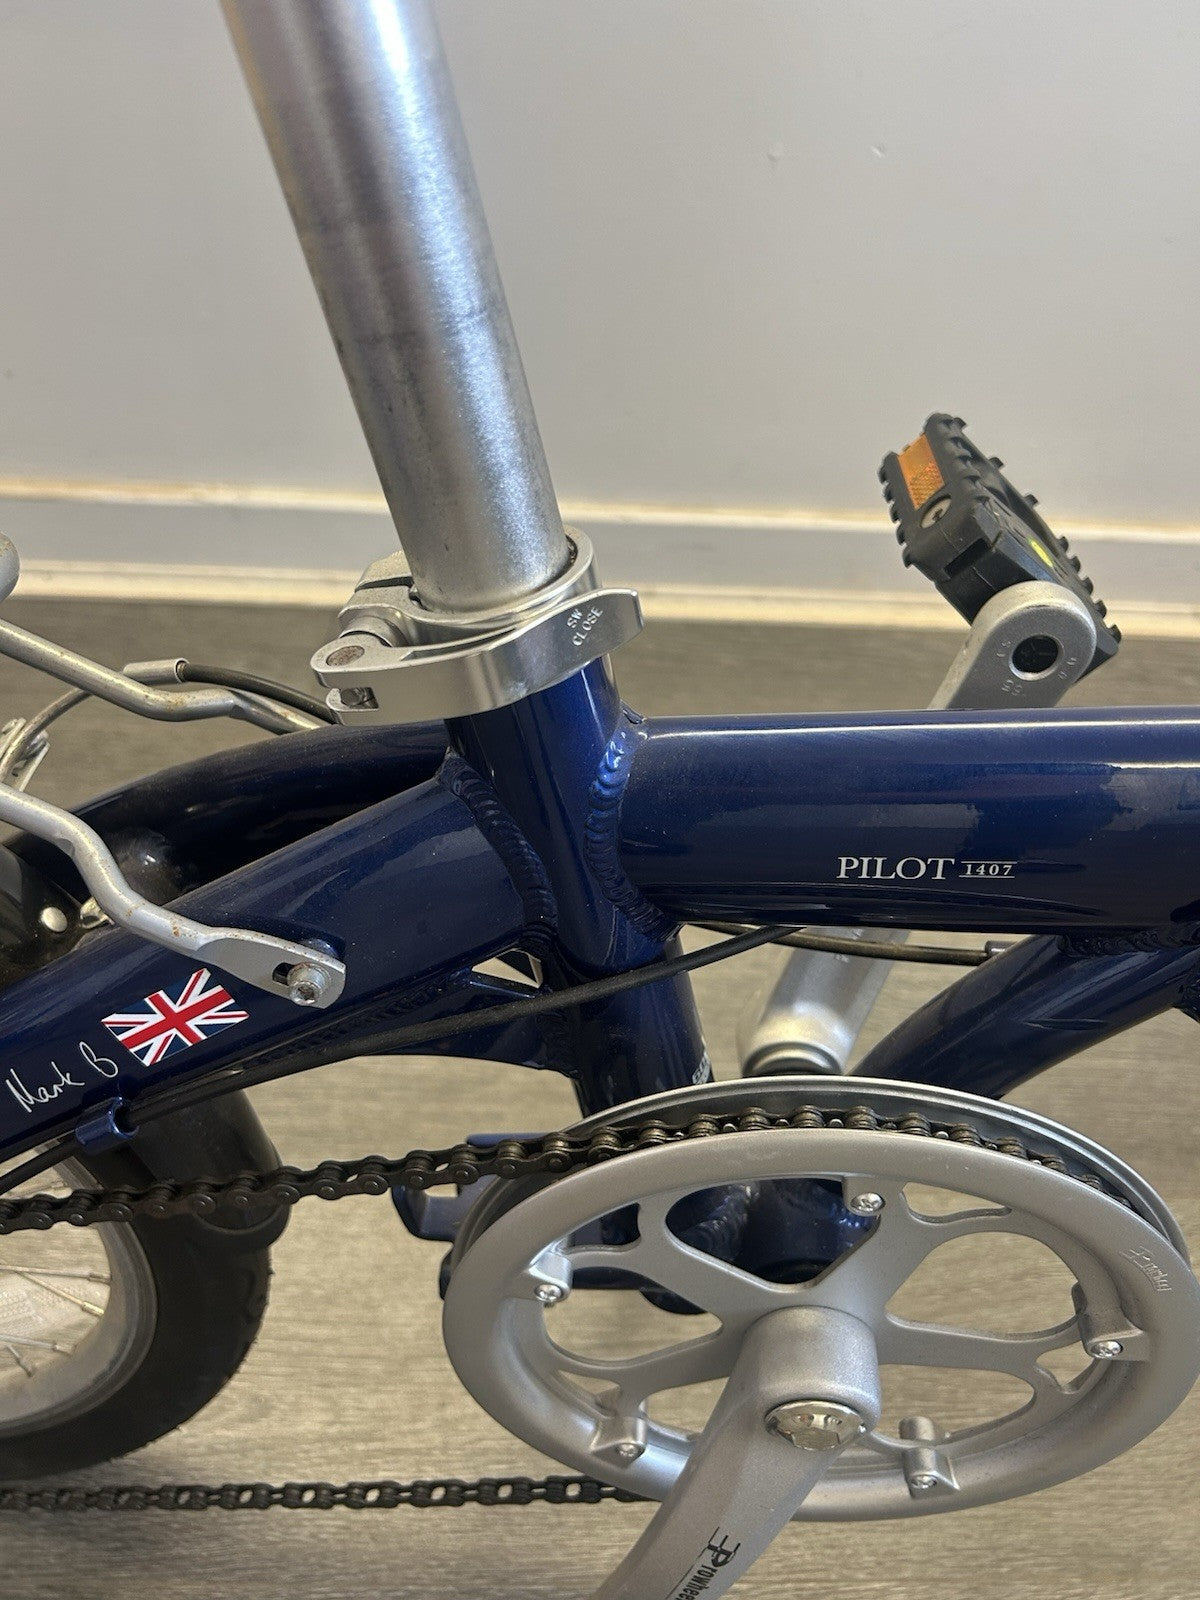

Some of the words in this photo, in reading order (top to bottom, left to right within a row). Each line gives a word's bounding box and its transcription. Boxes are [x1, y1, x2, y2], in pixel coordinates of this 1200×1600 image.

[573, 607, 603, 646] CLOSE
[836, 856, 955, 880] PILOT
[963, 863, 1014, 877] 1407
[5, 1061, 85, 1113] Mark
[79, 1041, 118, 1078] B
[674, 1527, 741, 1600] Prowhee
